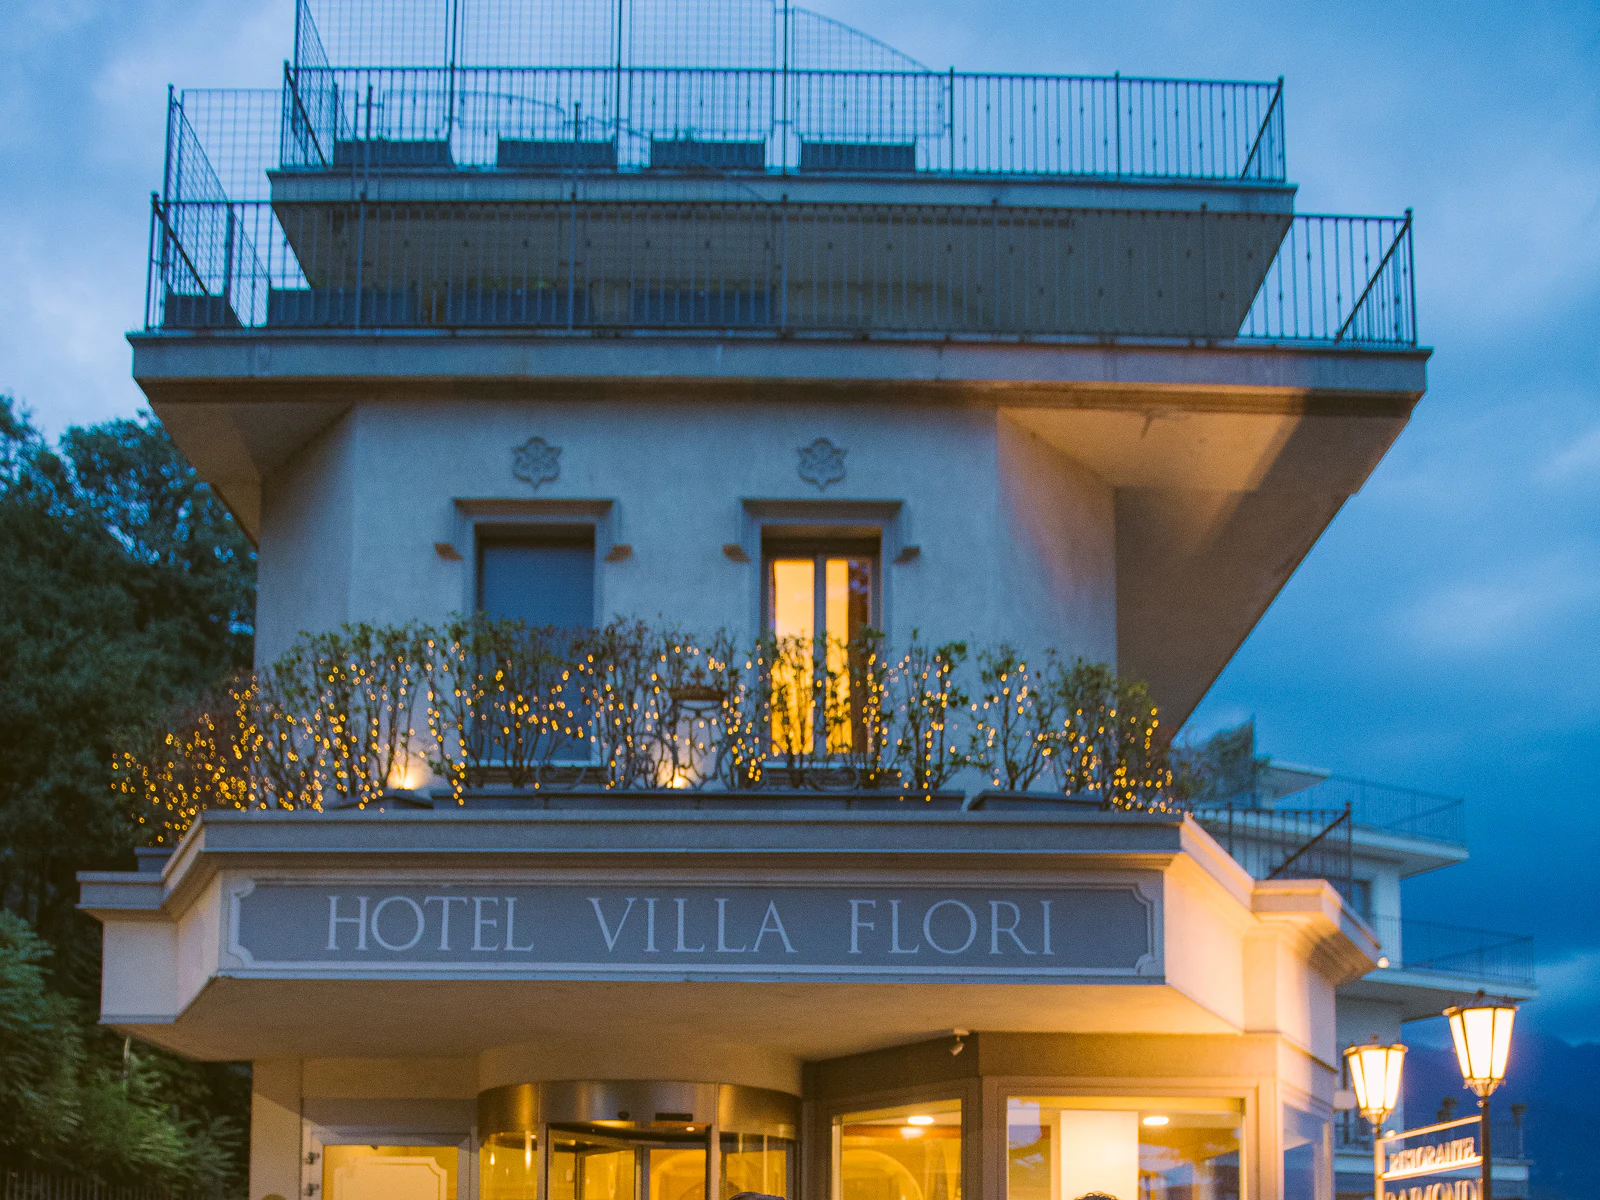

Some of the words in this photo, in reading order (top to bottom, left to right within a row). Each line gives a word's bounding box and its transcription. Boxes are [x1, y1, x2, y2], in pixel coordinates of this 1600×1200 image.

[325, 895, 534, 952] HOTEL
[586, 897, 799, 953] VILLA
[847, 898, 1056, 956] FLORI
